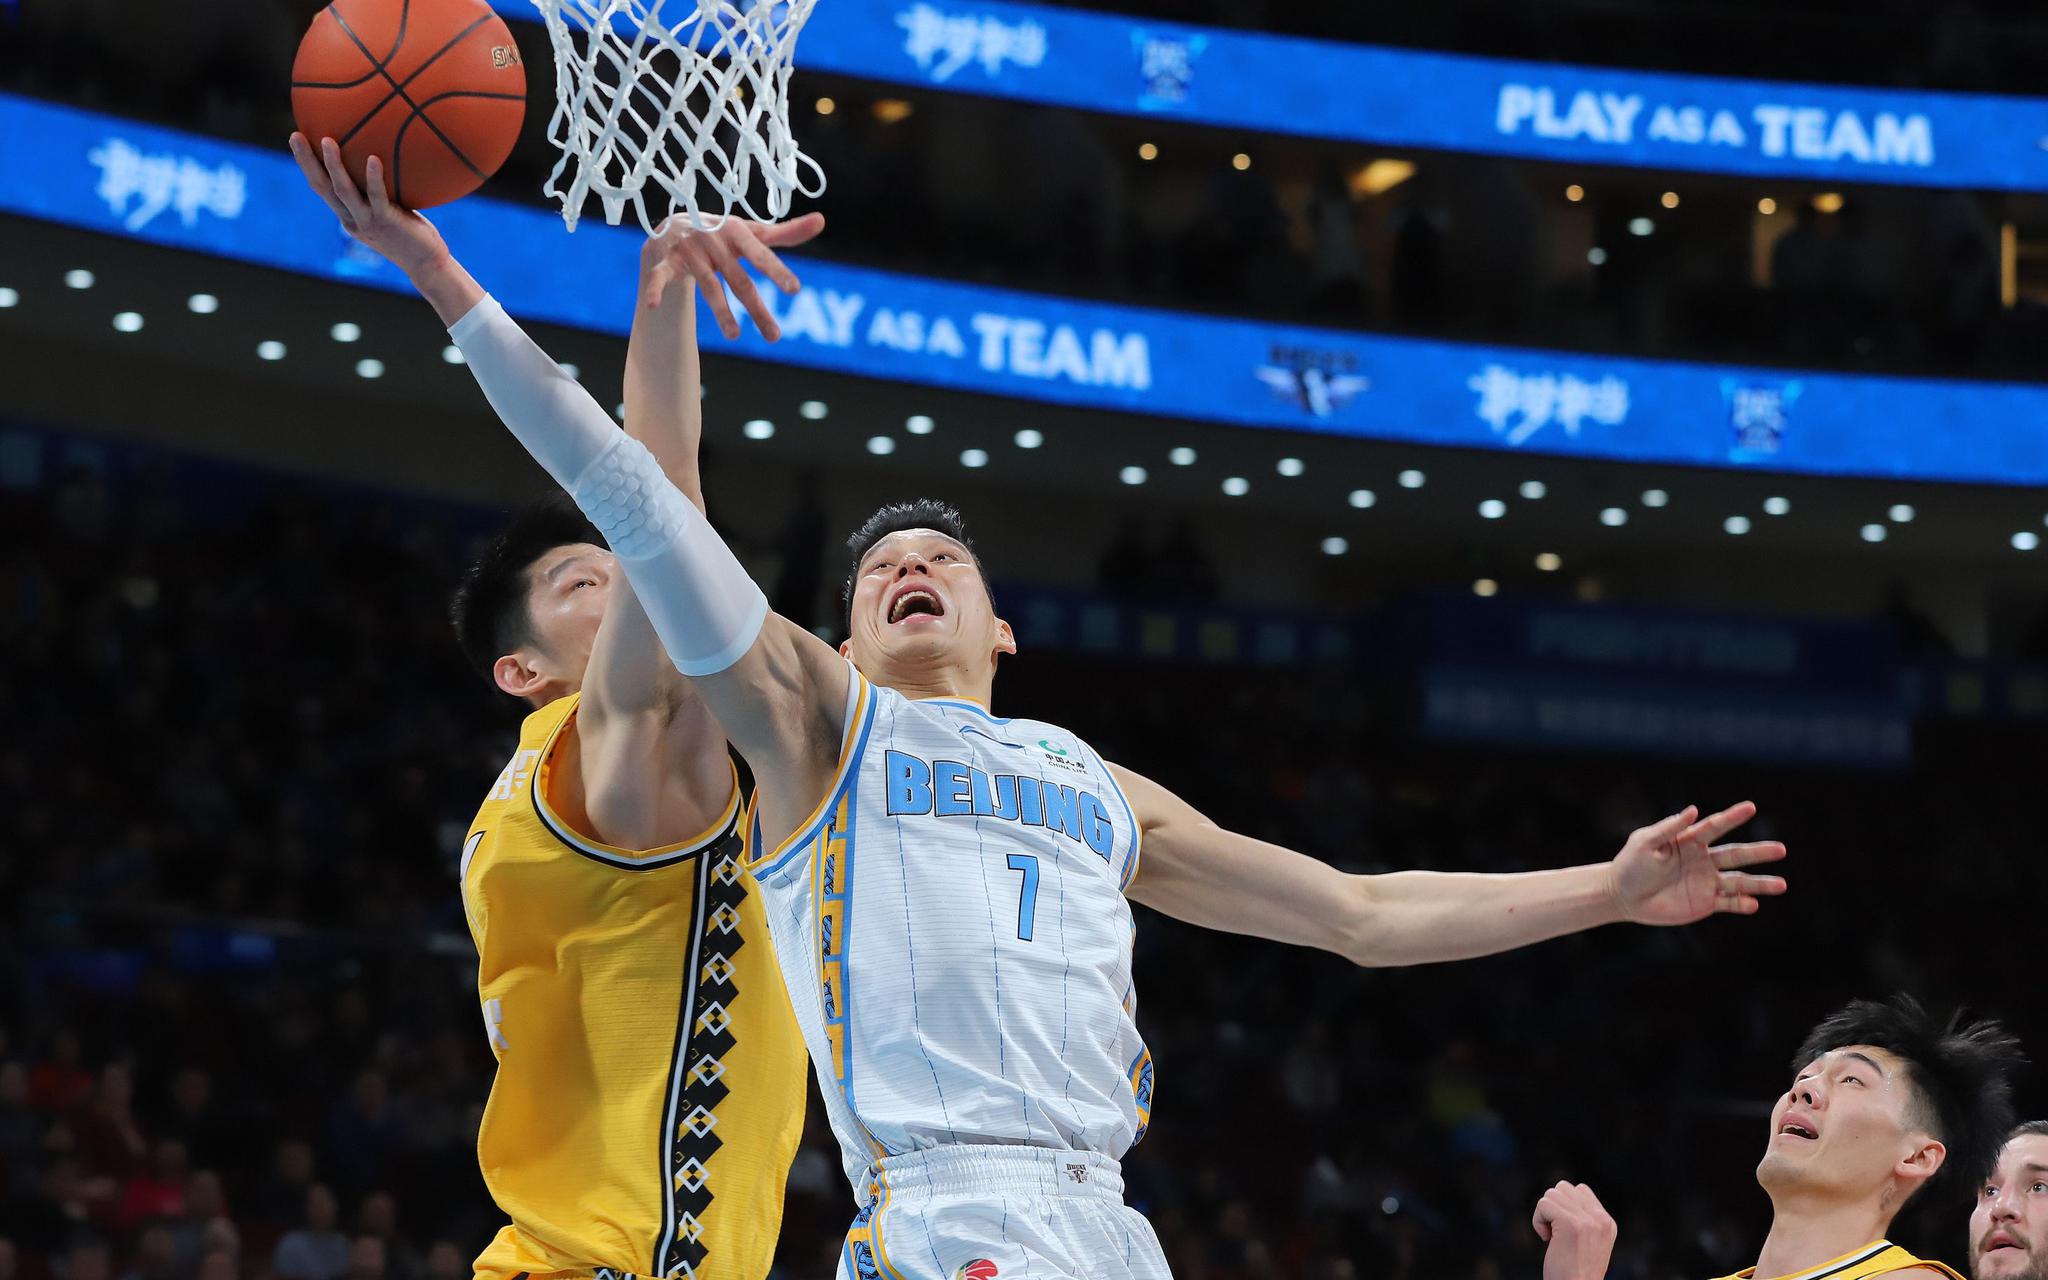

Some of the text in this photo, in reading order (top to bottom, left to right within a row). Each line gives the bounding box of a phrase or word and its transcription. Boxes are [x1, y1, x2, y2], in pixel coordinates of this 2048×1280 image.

[1498, 85, 1932, 165] PLAY AS A TEAM
[868, 309, 924, 351] AS
[926, 318, 964, 357] A
[971, 311, 1150, 389] TEAM
[885, 750, 1114, 864] BEIJING
[1006, 853, 1040, 942] 7
